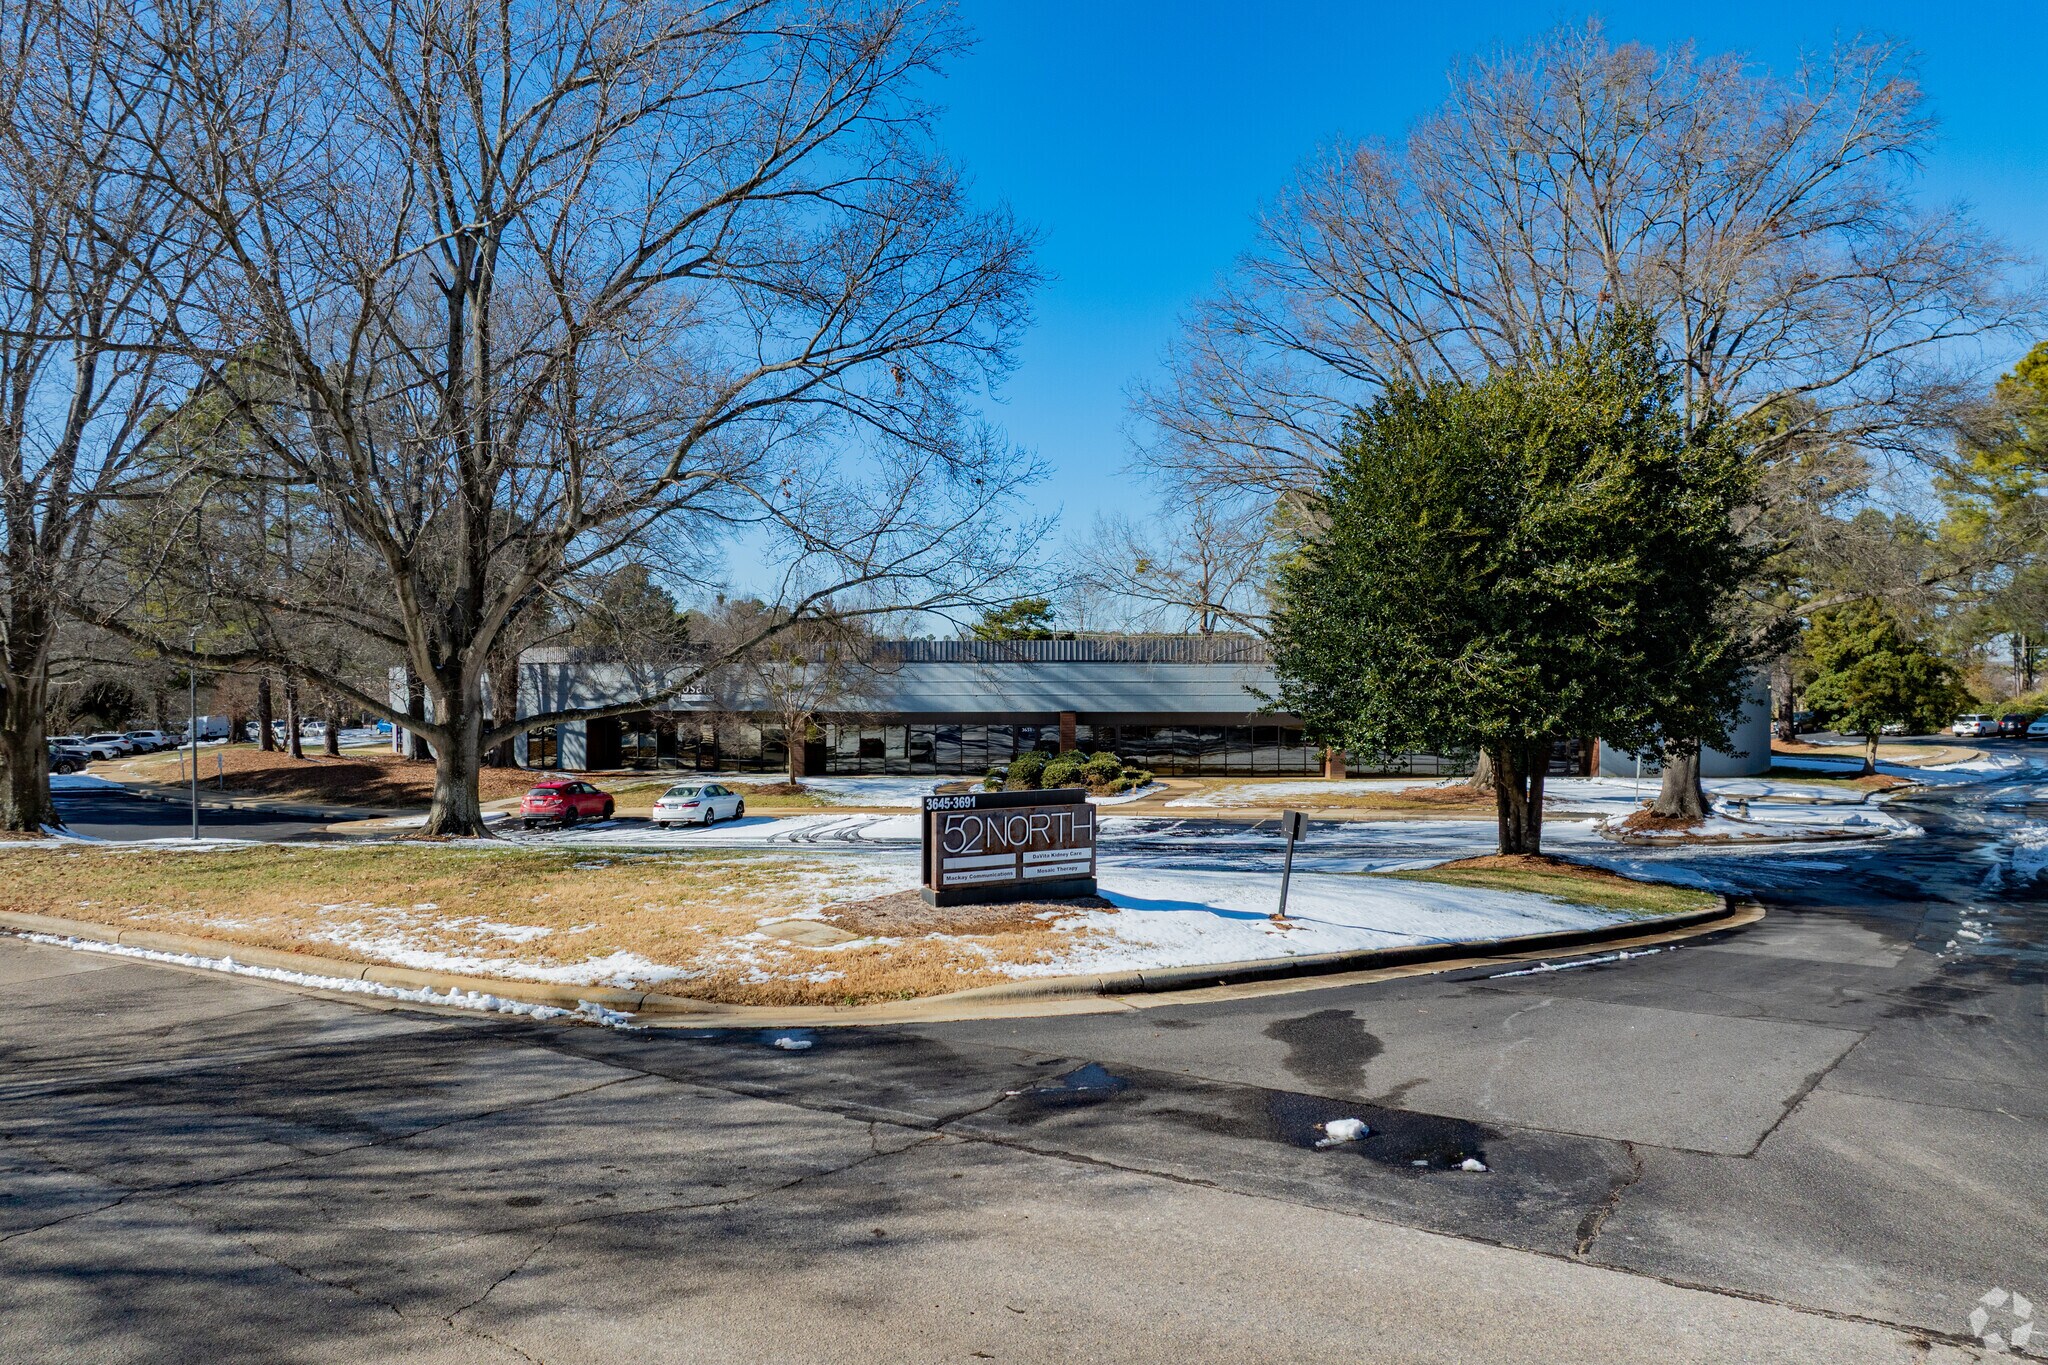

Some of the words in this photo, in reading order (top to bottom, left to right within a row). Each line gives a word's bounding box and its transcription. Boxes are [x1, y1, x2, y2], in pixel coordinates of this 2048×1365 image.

[926, 796, 976, 810] 3645-3691
[987, 811, 1092, 848] NORTH
[969, 871, 1013, 879] Communications
